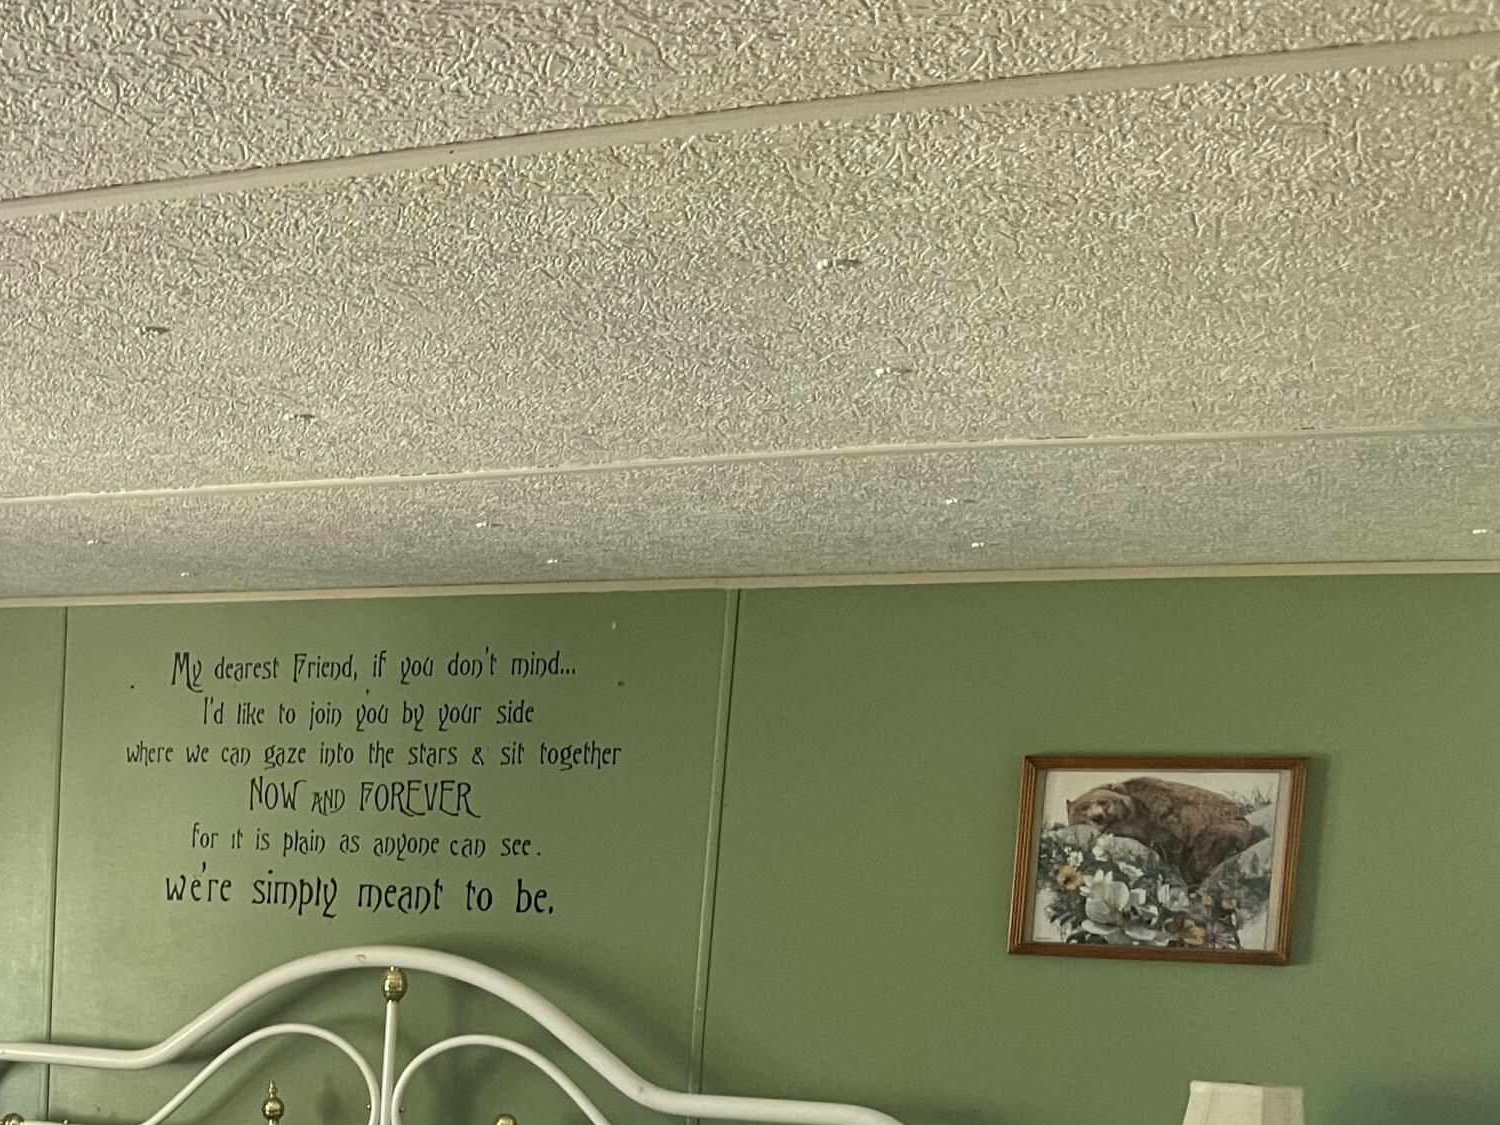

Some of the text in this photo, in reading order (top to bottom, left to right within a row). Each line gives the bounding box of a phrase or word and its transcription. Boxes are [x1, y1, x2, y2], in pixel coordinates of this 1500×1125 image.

[170, 645, 576, 694] My dearest Friend, if you don't mind...
[203, 695, 535, 733] I'd like to join you by your side
[126, 739, 622, 772] where we can gaze into the stars & sit together
[249, 775, 482, 819] NOW AND FOREVER
[191, 821, 219, 849] for
[231, 827, 244, 850] it
[255, 827, 271, 852] is
[282, 828, 326, 858] plain
[339, 833, 360, 854] as
[372, 832, 440, 862] anyone
[449, 837, 486, 859] can
[165, 860, 554, 920] we're simply meant to be.
